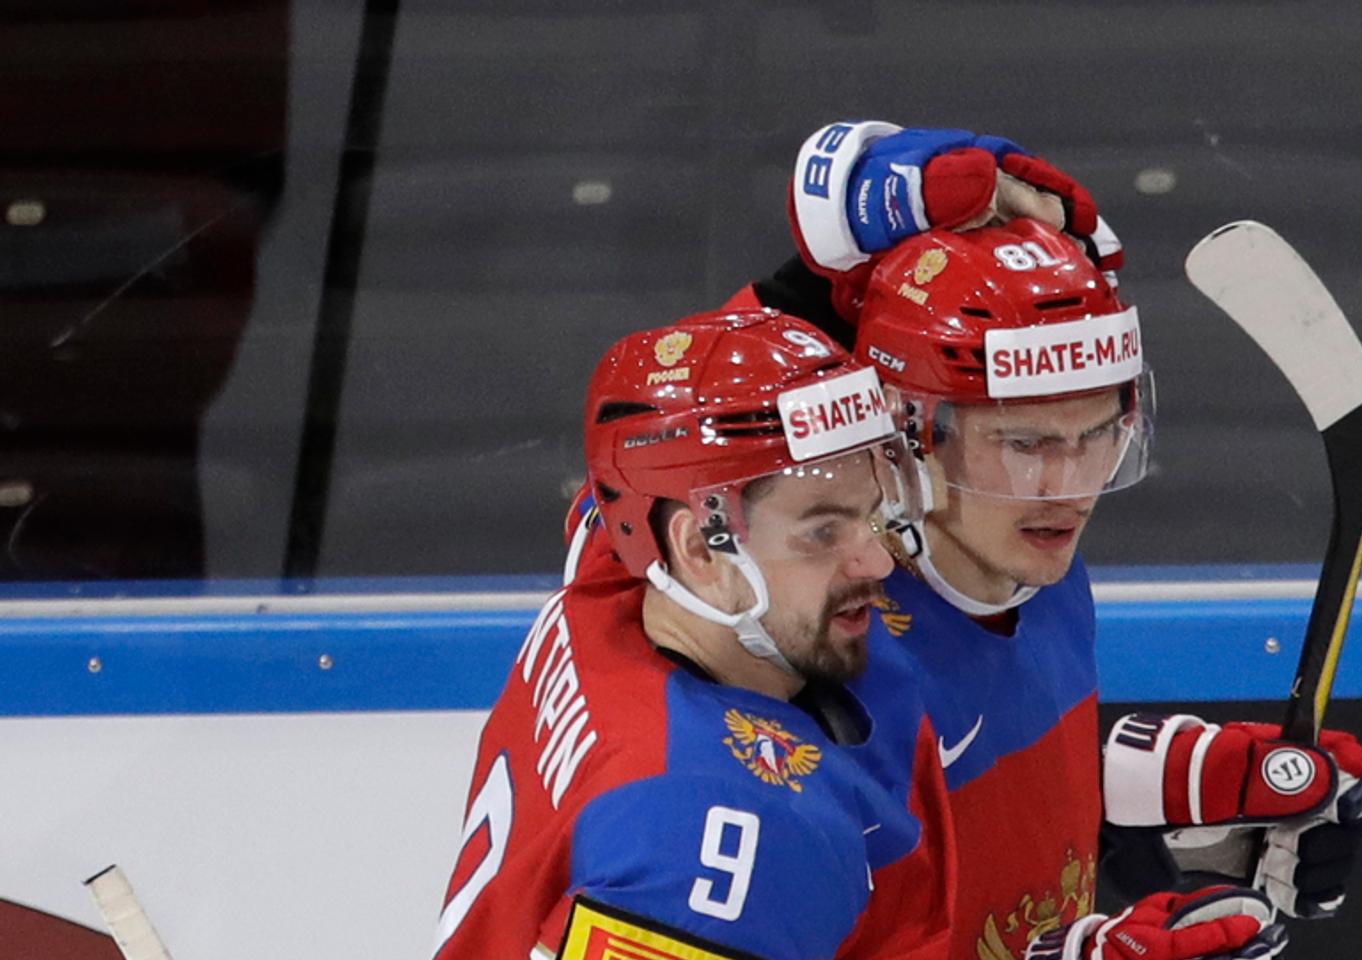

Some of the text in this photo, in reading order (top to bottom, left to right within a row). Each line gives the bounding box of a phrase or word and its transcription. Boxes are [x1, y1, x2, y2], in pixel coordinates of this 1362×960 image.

[994, 241, 1060, 271] 81
[782, 329, 831, 358] 9
[868, 345, 906, 372] CCM
[992, 331, 1139, 378] SHATE-M.RU
[688, 805, 760, 922] 9
